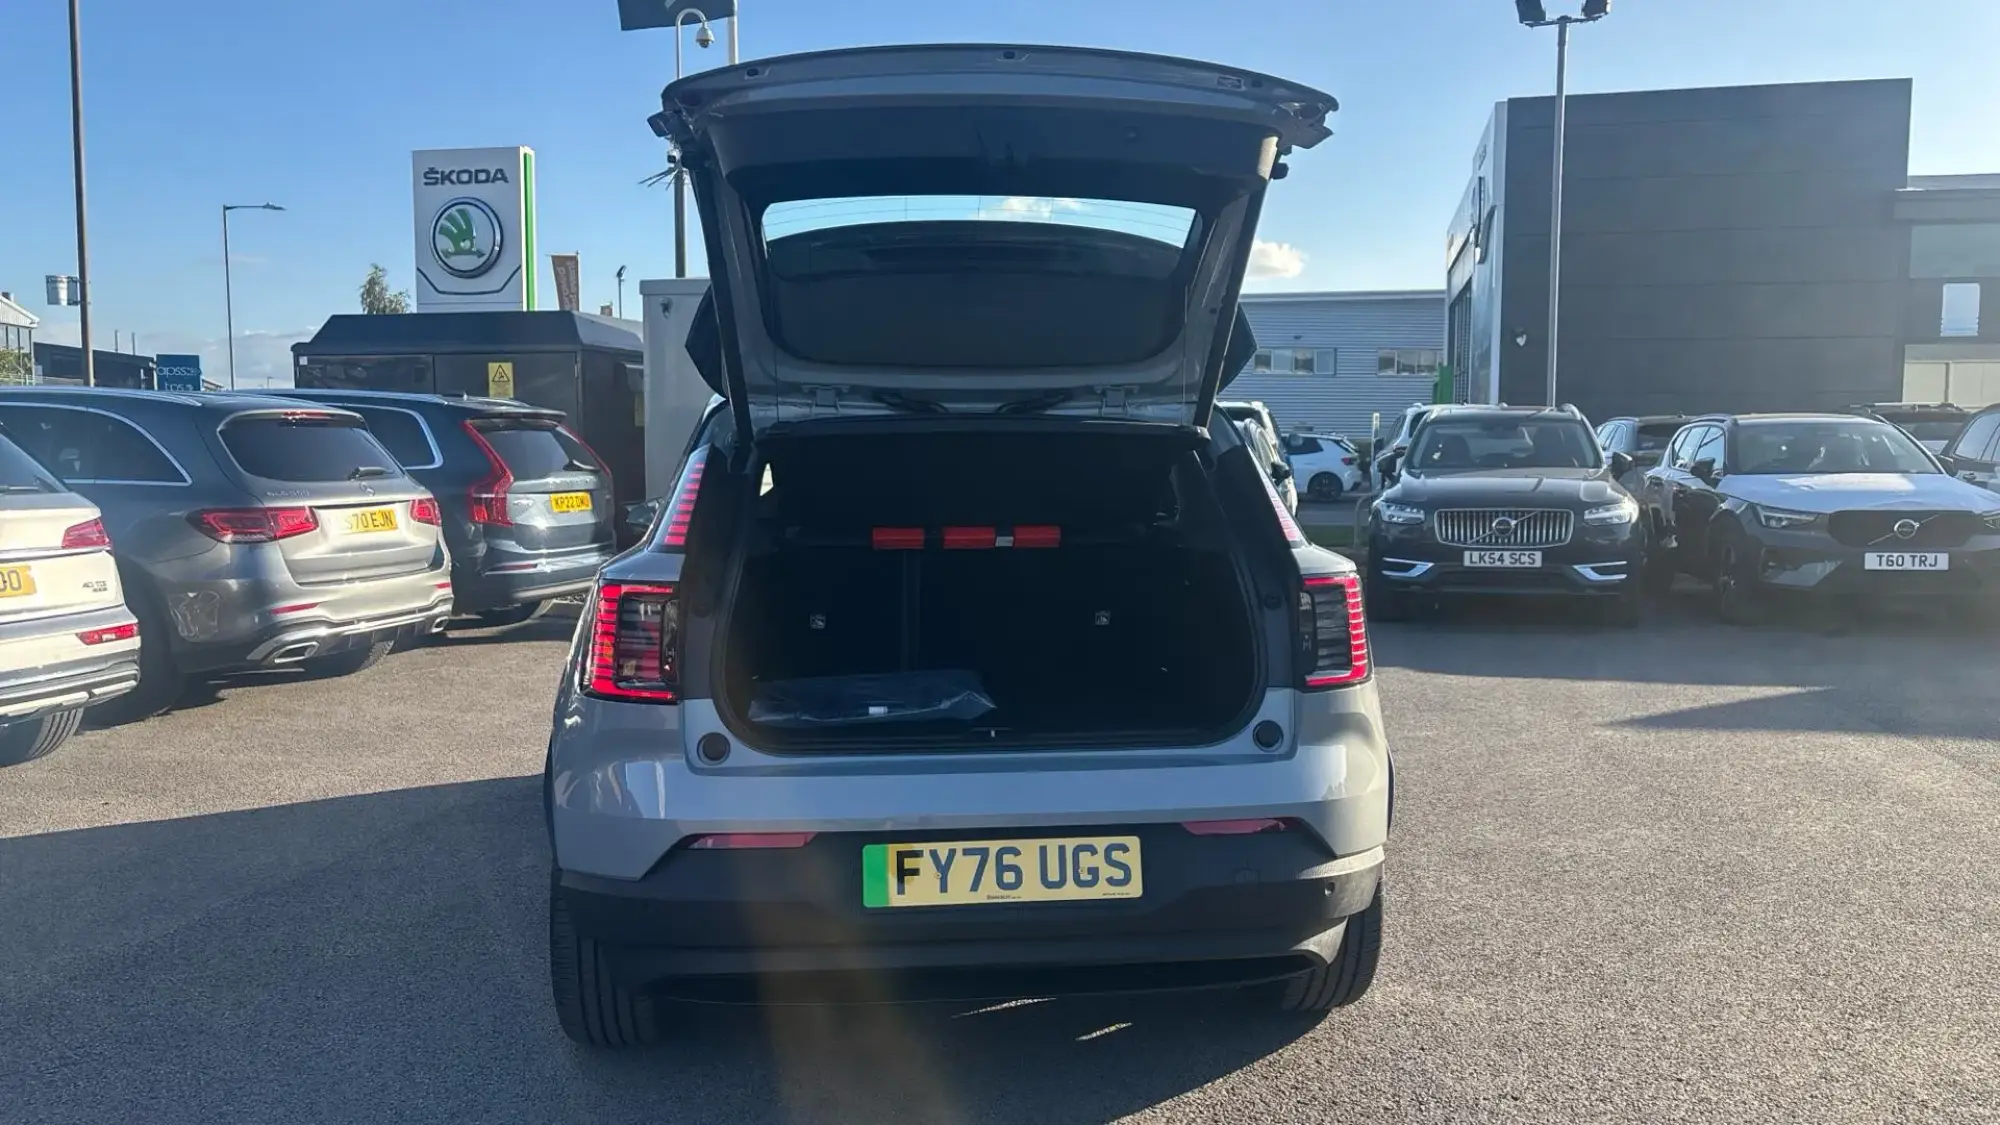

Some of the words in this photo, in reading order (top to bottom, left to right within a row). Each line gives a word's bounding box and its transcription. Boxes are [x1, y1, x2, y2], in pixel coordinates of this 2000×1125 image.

[423, 167, 509, 186] ŠKODA
[370, 511, 394, 528] EJN
[1469, 552, 1505, 565] LK54
[1509, 552, 1536, 565] SCS
[1876, 554, 1905, 567] T60
[1909, 554, 1938, 567] TRJ
[896, 846, 1024, 895] FY76
[1038, 843, 1132, 889] UGS
